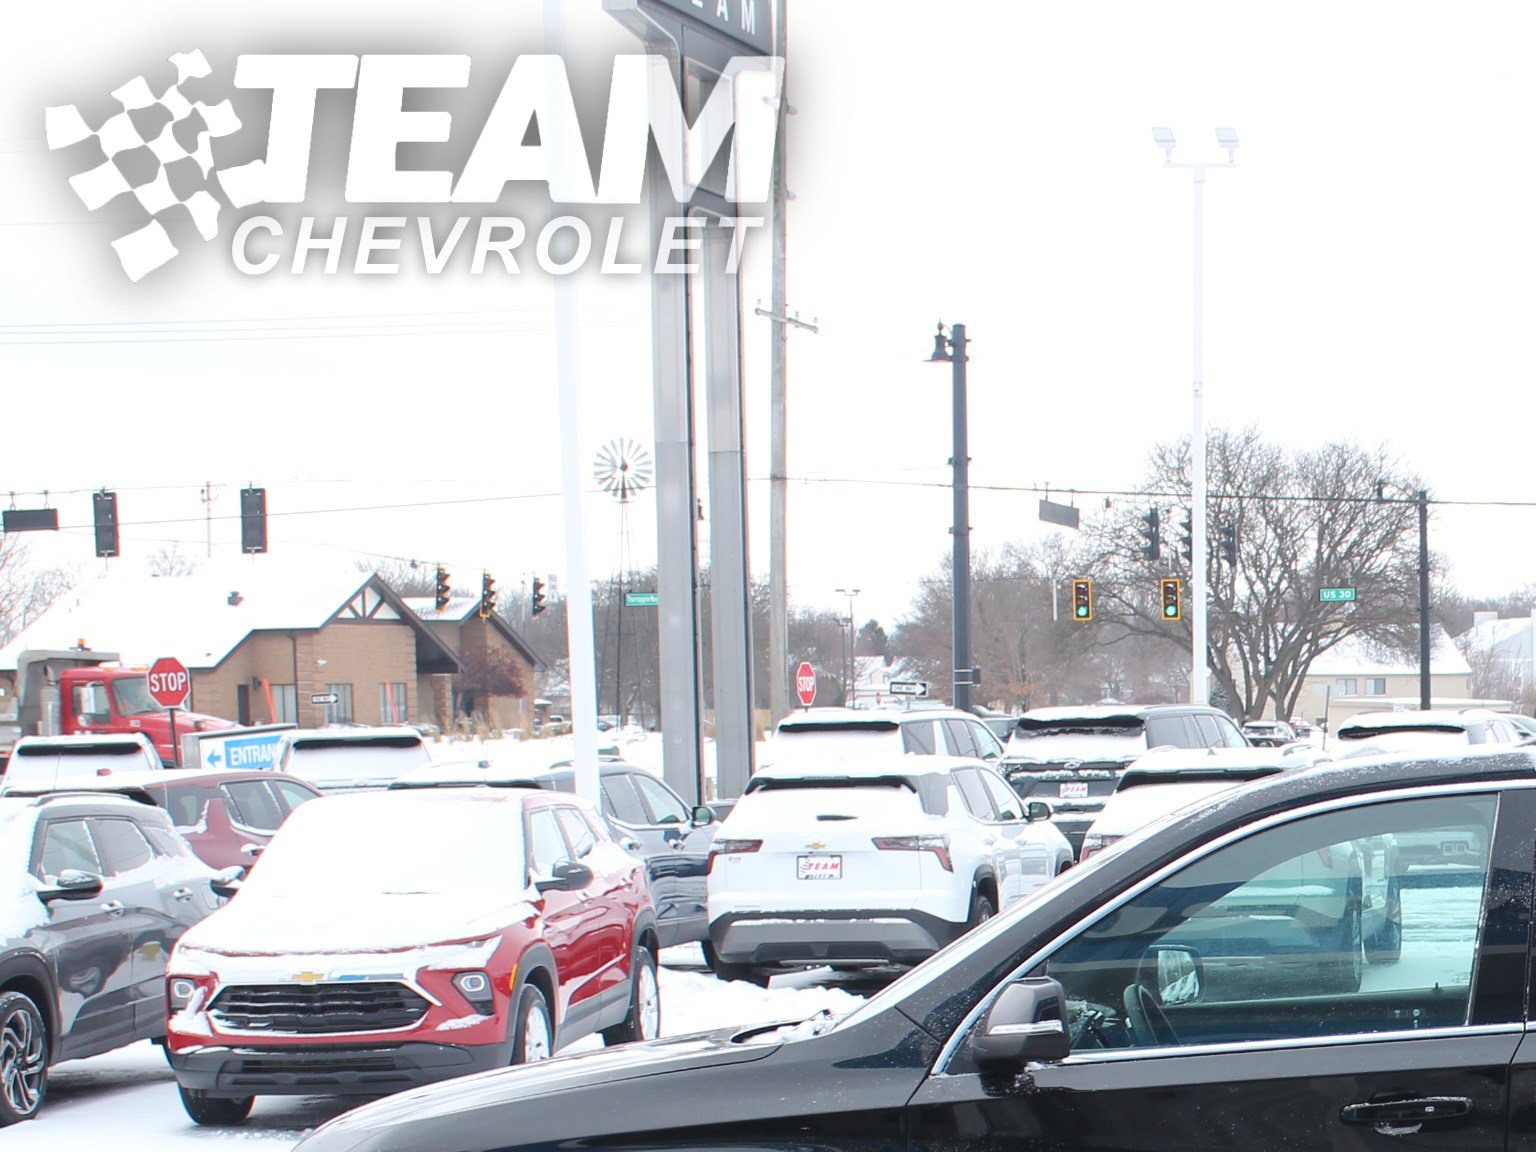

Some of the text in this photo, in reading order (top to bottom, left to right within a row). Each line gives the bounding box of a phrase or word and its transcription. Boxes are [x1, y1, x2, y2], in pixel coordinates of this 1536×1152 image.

[691, 0, 756, 35] AM
[1323, 590, 1352, 599] US 30
[150, 672, 186, 693] STOP
[798, 676, 815, 692] STOP
[231, 743, 277, 766] ENTRAN
[807, 862, 839, 871] TEAM
